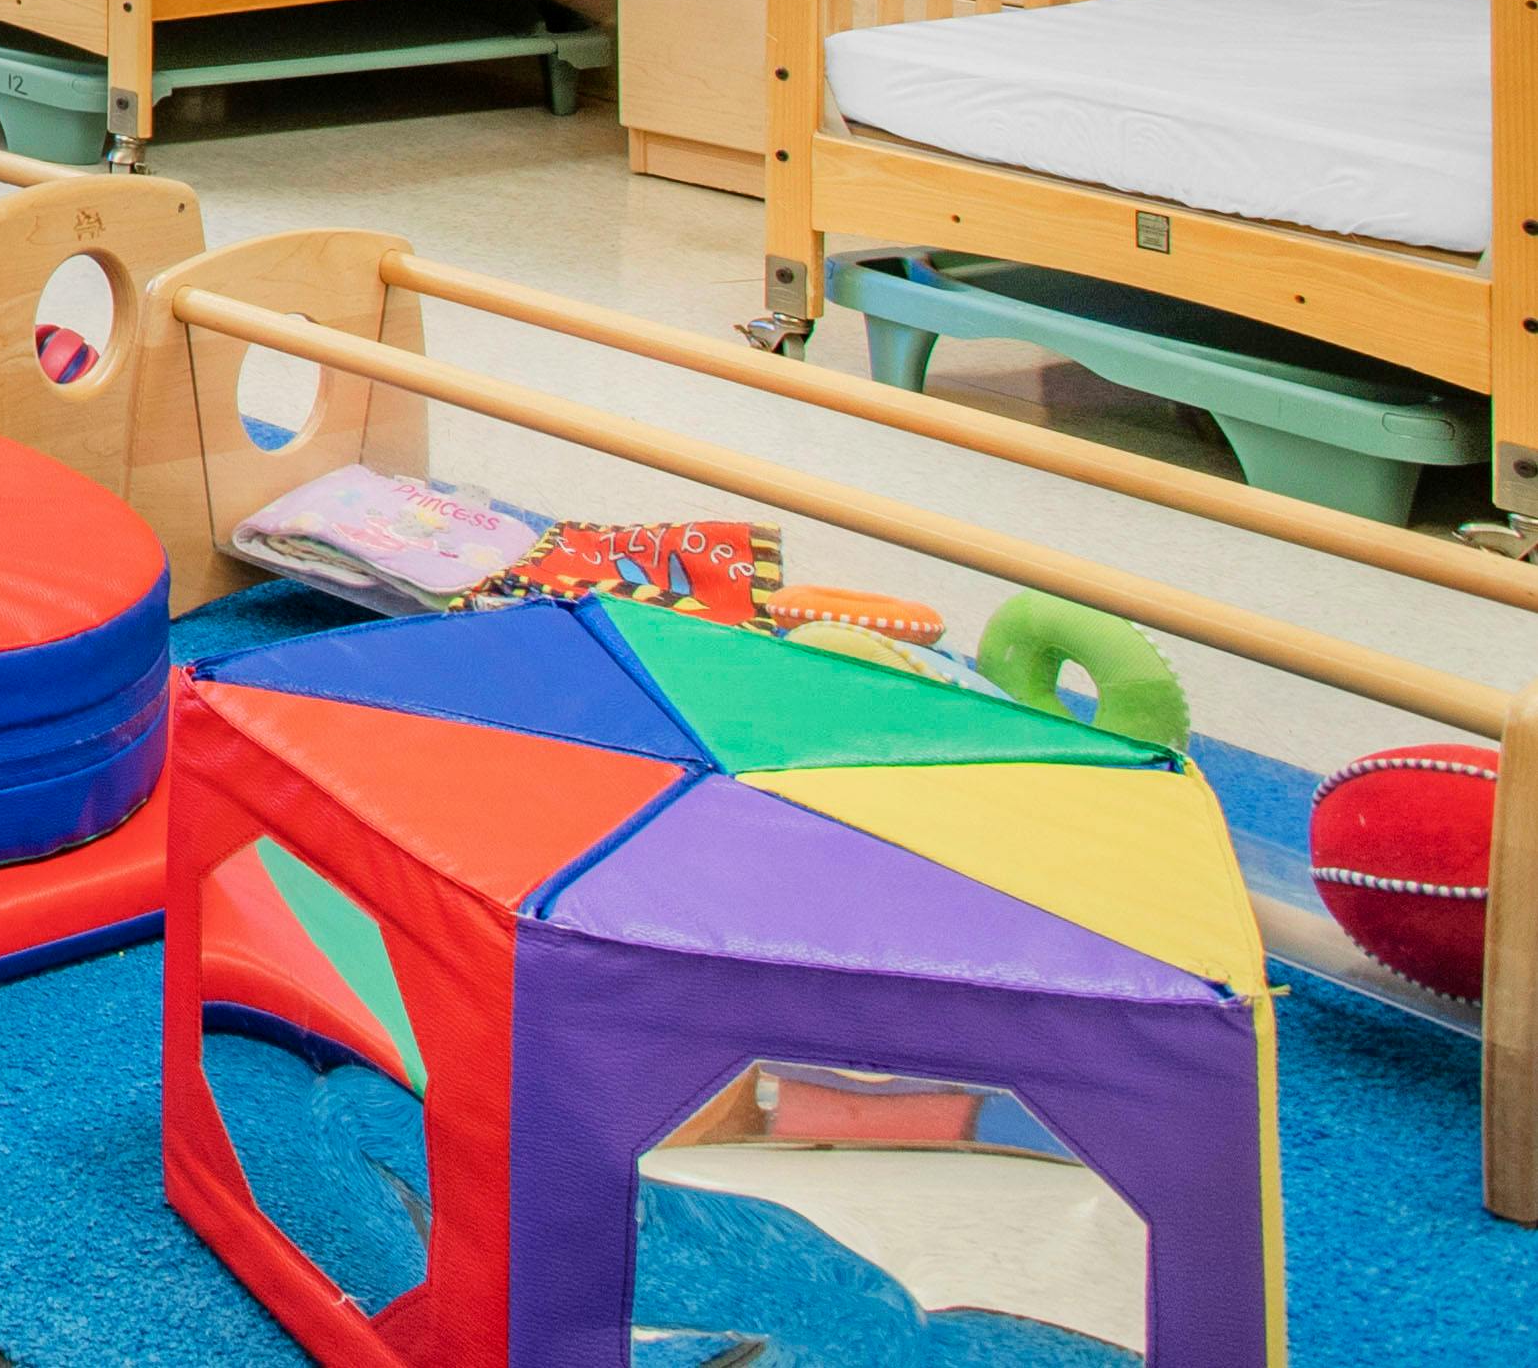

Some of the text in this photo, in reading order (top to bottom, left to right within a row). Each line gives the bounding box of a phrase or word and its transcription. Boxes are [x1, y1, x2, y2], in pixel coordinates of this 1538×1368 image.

[8, 73, 28, 95] 12
[393, 483, 501, 533] Princess
[680, 524, 756, 582] bee
